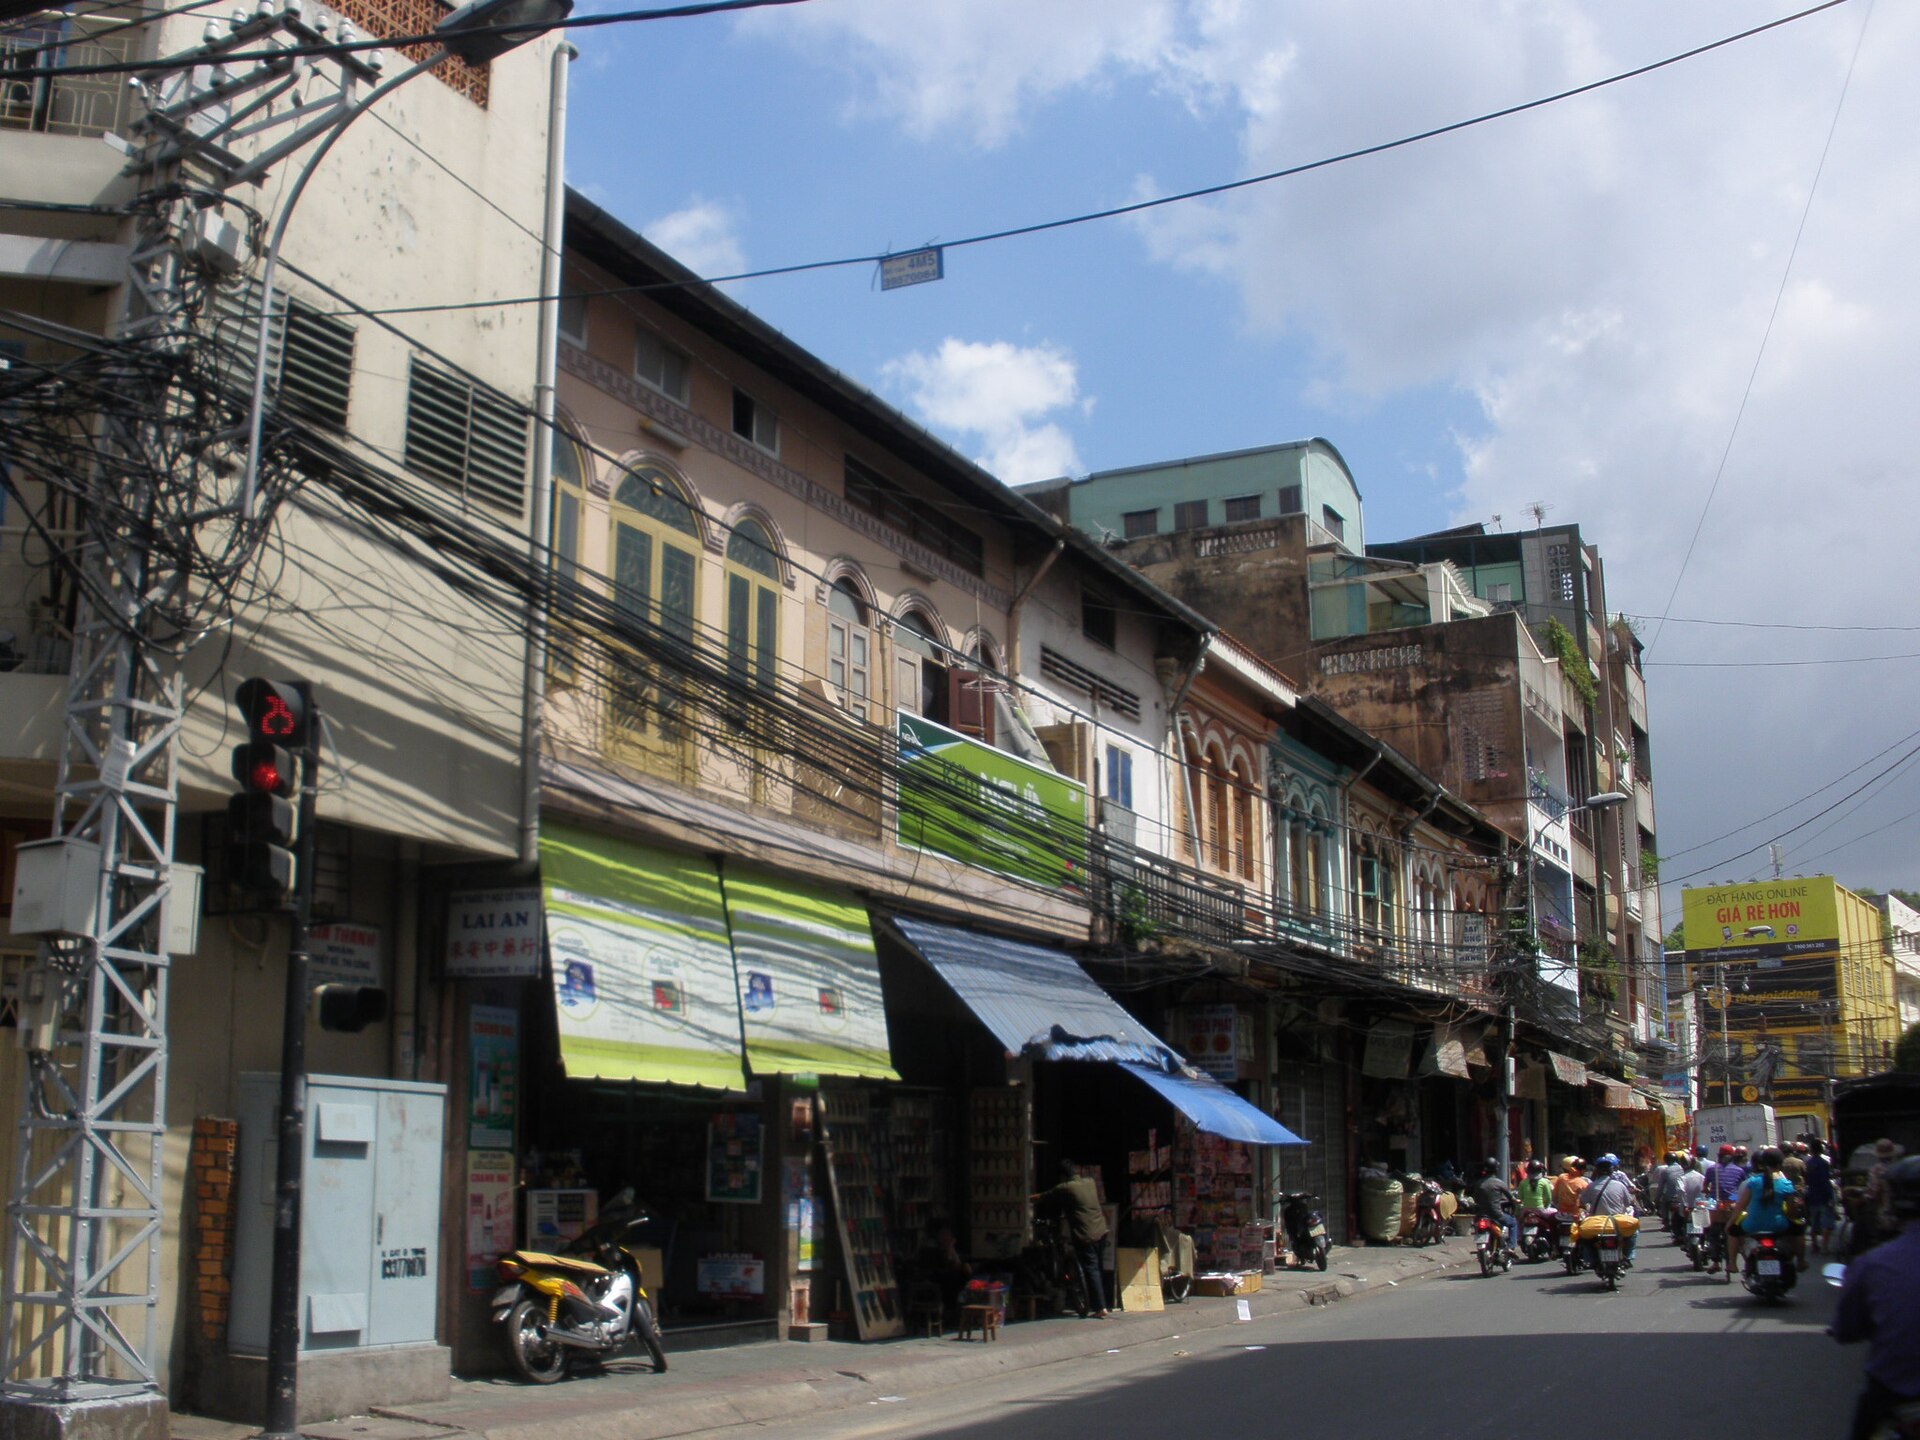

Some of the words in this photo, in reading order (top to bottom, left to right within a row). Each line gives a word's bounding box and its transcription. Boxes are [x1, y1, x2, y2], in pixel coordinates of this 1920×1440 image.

[1731, 889, 1763, 903] HÀNG
[1766, 886, 1808, 899] ONLINE
[462, 912, 495, 929] LAI
[499, 911, 529, 928] AN
[1716, 903, 1742, 924] GIÁ
[1746, 901, 1766, 921] RẺ
[1768, 901, 1801, 920] HƠN
